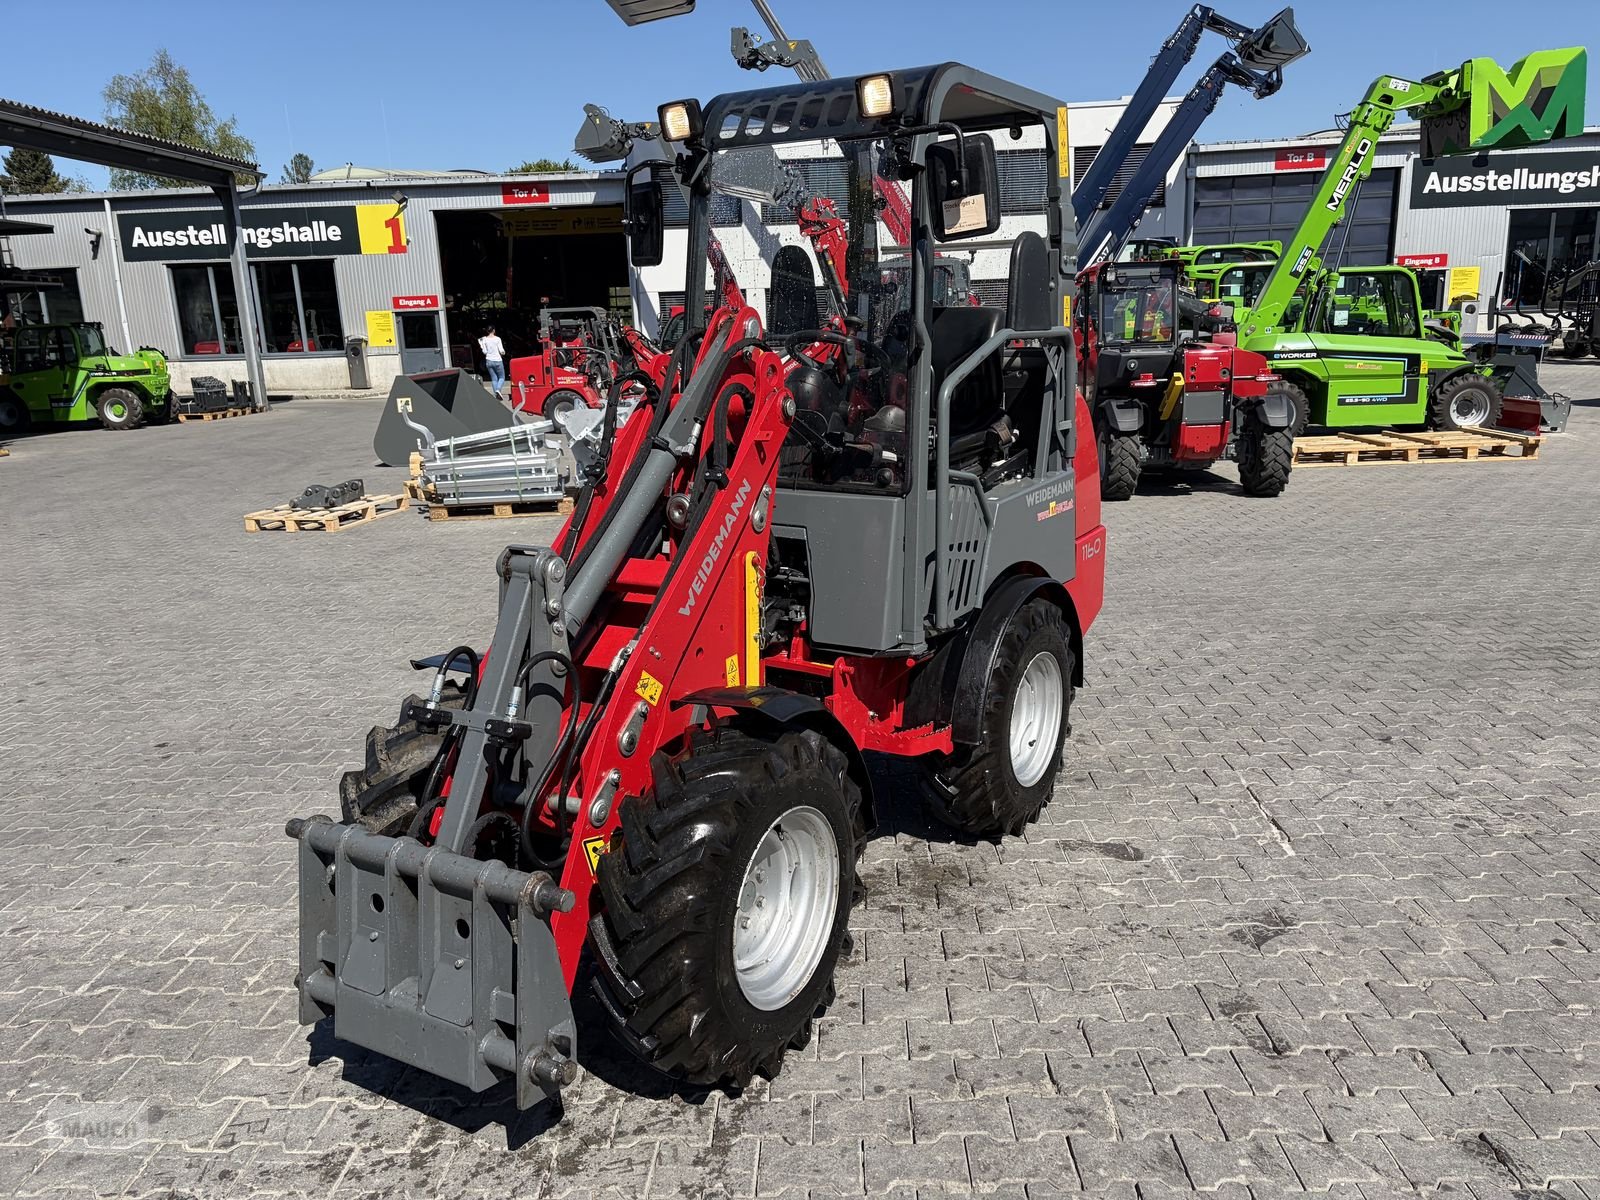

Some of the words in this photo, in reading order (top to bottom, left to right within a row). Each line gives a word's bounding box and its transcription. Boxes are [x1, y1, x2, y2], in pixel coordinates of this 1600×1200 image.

[1287, 153, 1304, 163] Tor
[1307, 152, 1315, 162] B
[1326, 138, 1372, 212] MERLO
[512, 188, 529, 198] Tor
[531, 187, 539, 197] A
[132, 220, 342, 248] Ausstellngshalle
[385, 218, 407, 254] 1
[1297, 249, 1313, 273] 25.5
[1404, 258, 1433, 266] Eingang
[399, 299, 425, 307] Eingang
[1025, 478, 1074, 508] WEIDEMANN
[678, 478, 752, 616] WEIDEMANN
[1082, 537, 1101, 561] 1160
